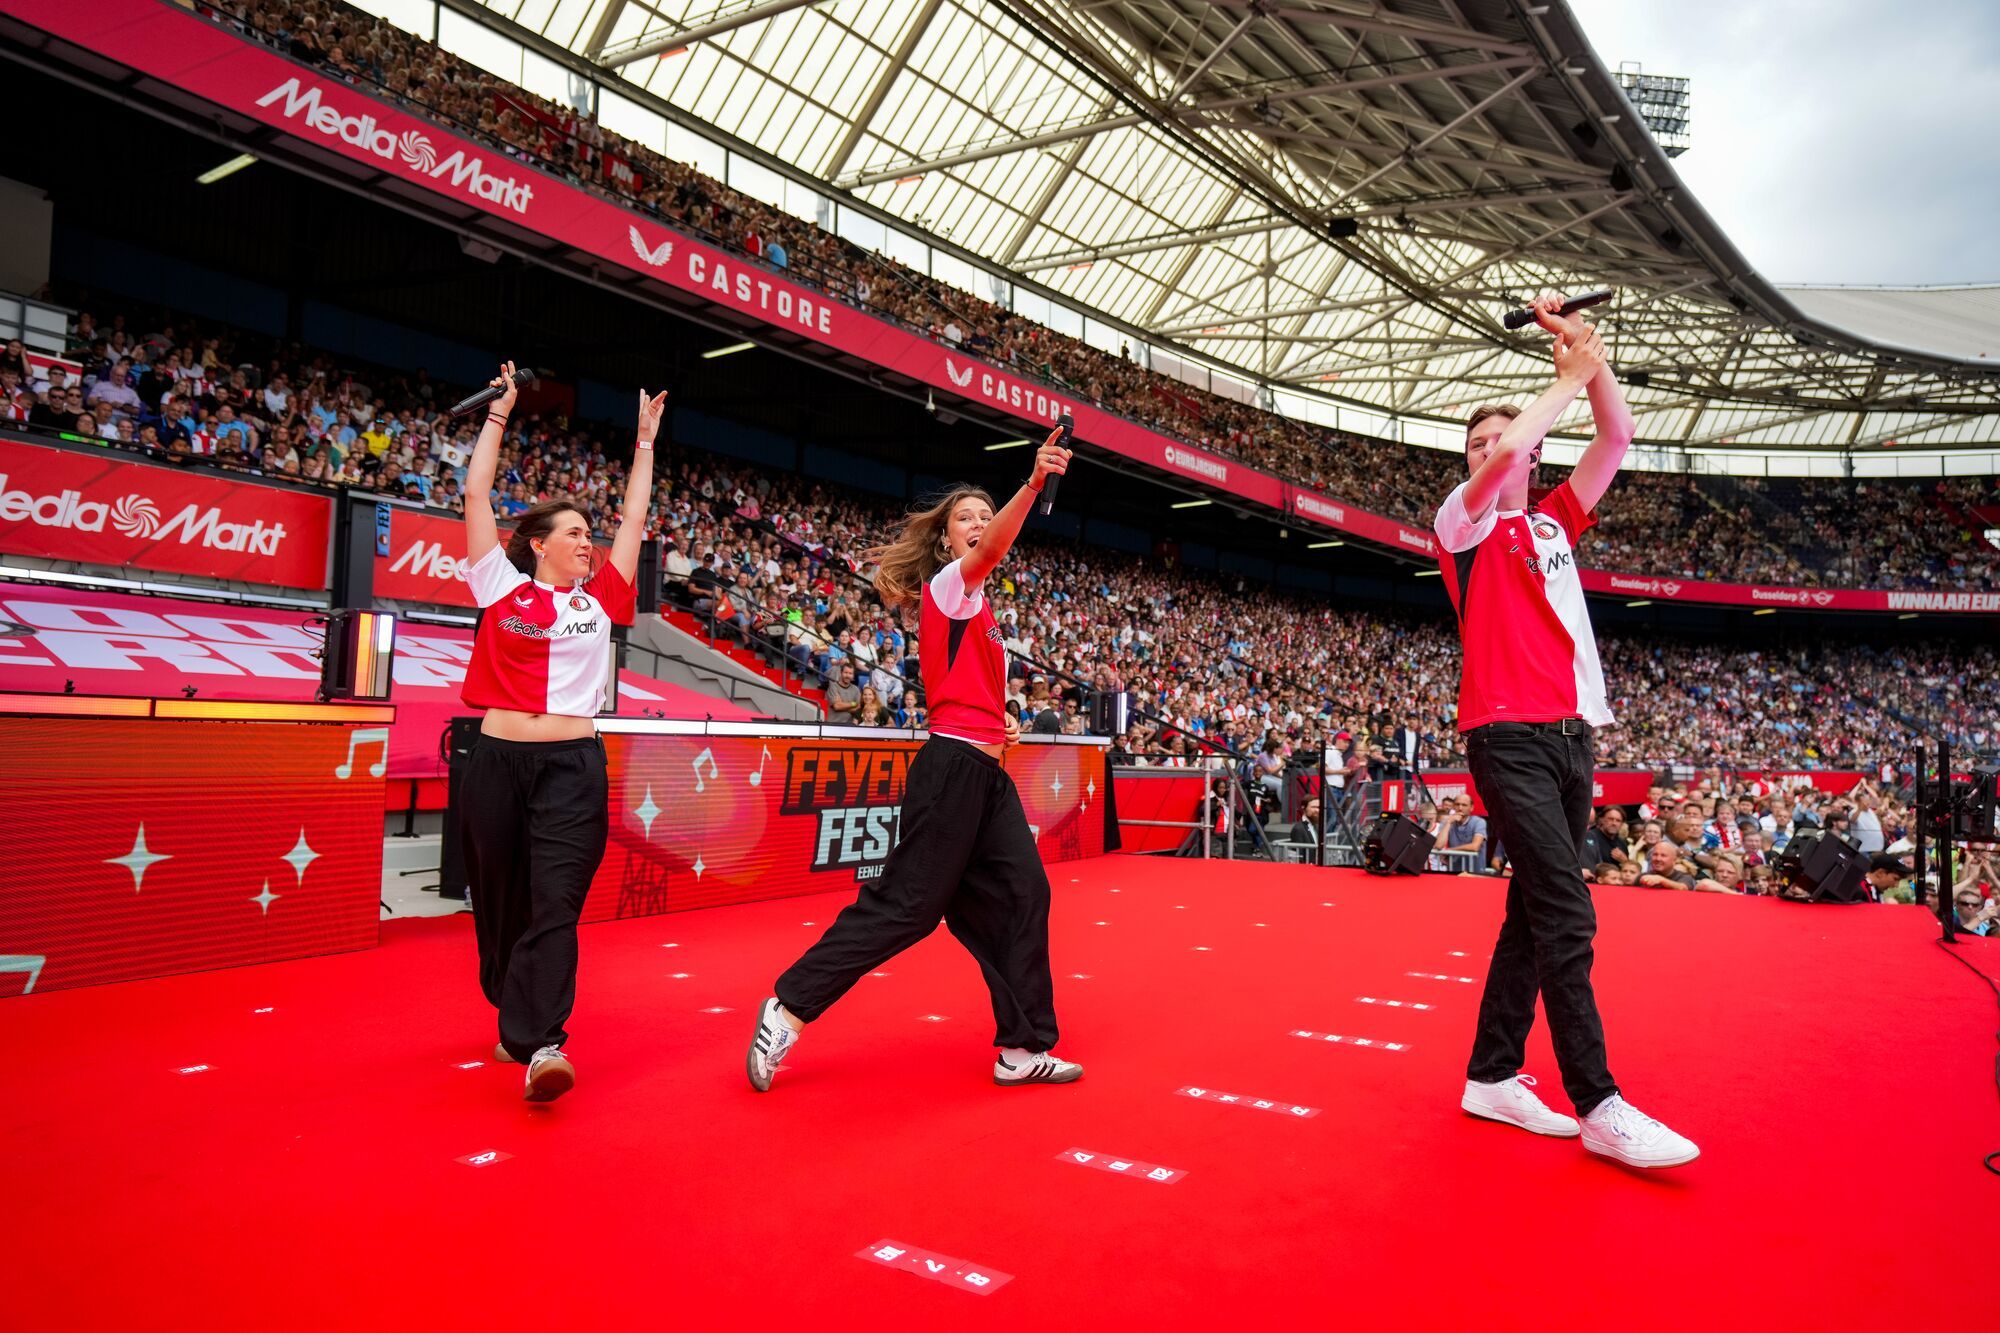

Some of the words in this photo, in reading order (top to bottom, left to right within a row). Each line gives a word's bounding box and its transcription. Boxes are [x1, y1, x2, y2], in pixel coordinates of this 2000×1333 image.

[255, 77, 398, 160] Media
[429, 150, 534, 214] Markt
[688, 252, 832, 335] CASTORE
[1175, 448, 1227, 483] EUROJACKPOT
[149, 503, 287, 556] Markt
[1611, 577, 1651, 592] Dusseldorp
[1752, 589, 1798, 602] Dusseldorp
[1887, 592, 1970, 610] WINNAAR
[498, 616, 544, 638] Media
[560, 620, 598, 636] Markt
[857, 866, 874, 879] EEN
